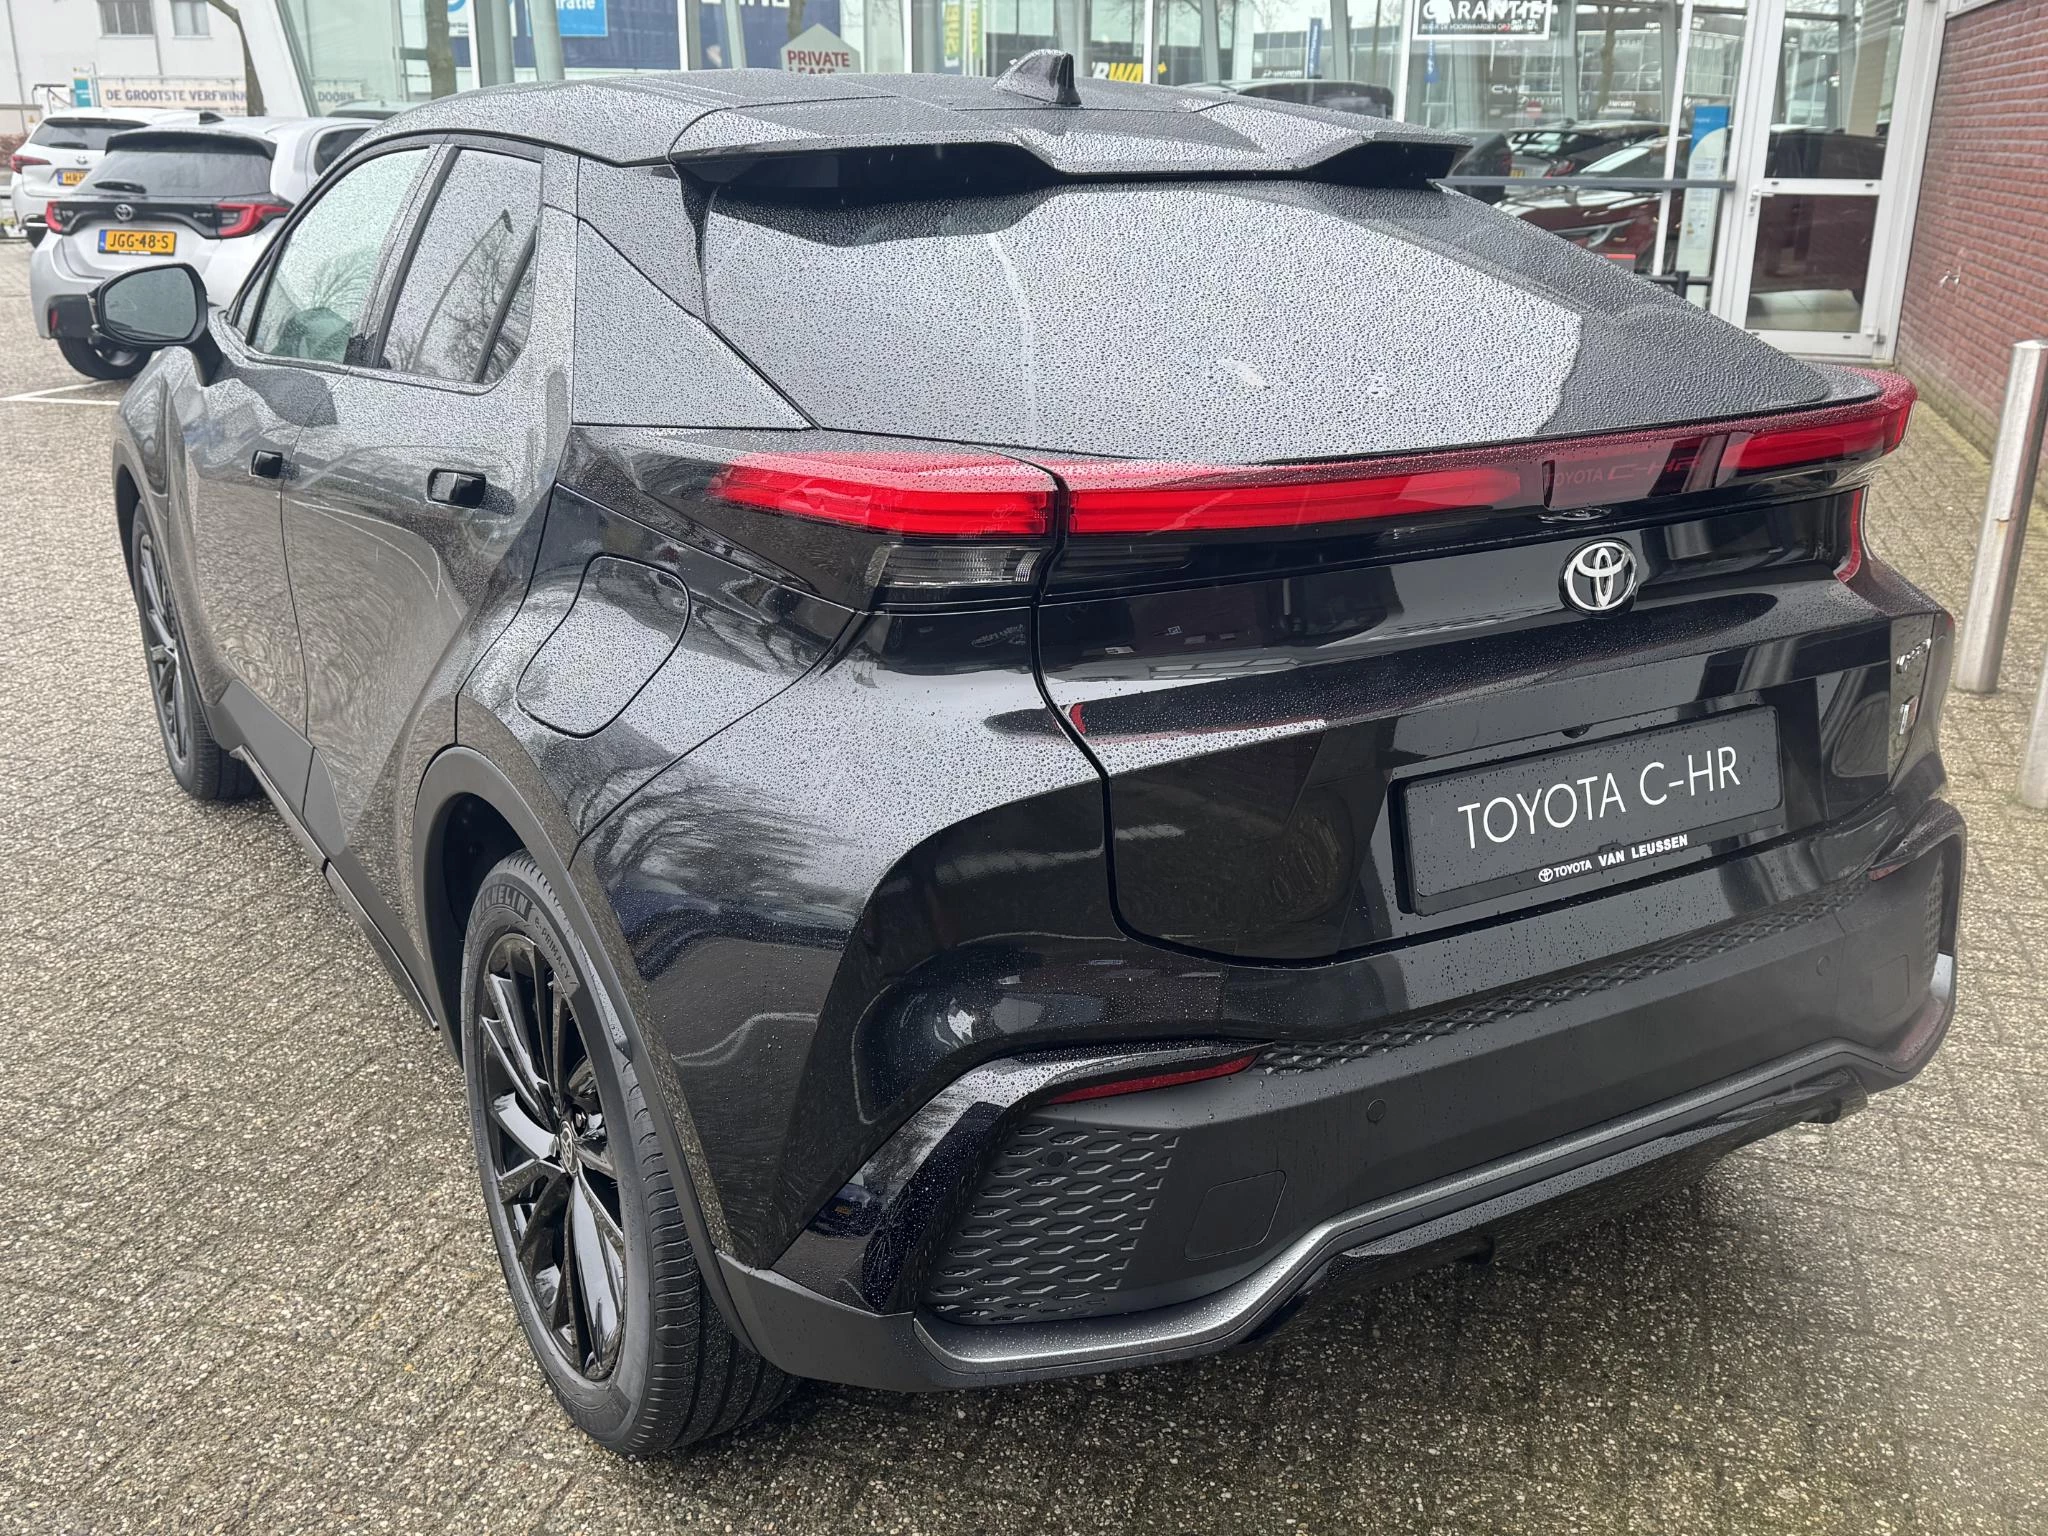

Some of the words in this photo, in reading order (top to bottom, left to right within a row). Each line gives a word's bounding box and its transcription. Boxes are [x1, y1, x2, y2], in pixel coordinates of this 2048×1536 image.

[787, 50, 850, 67] PRIVATE
[106, 89, 121, 100] DE
[125, 89, 185, 101] GROOTSTE
[109, 234, 169, 250] JGG-48-S
[1457, 772, 1627, 849] TOYOTA
[1639, 746, 1741, 806] C-HR
[1553, 859, 1592, 879] TOYOTA
[1598, 848, 1626, 868] VAN
[1631, 834, 1689, 860] LEUSSEN
[533, 915, 571, 980] e-PRIMACY
